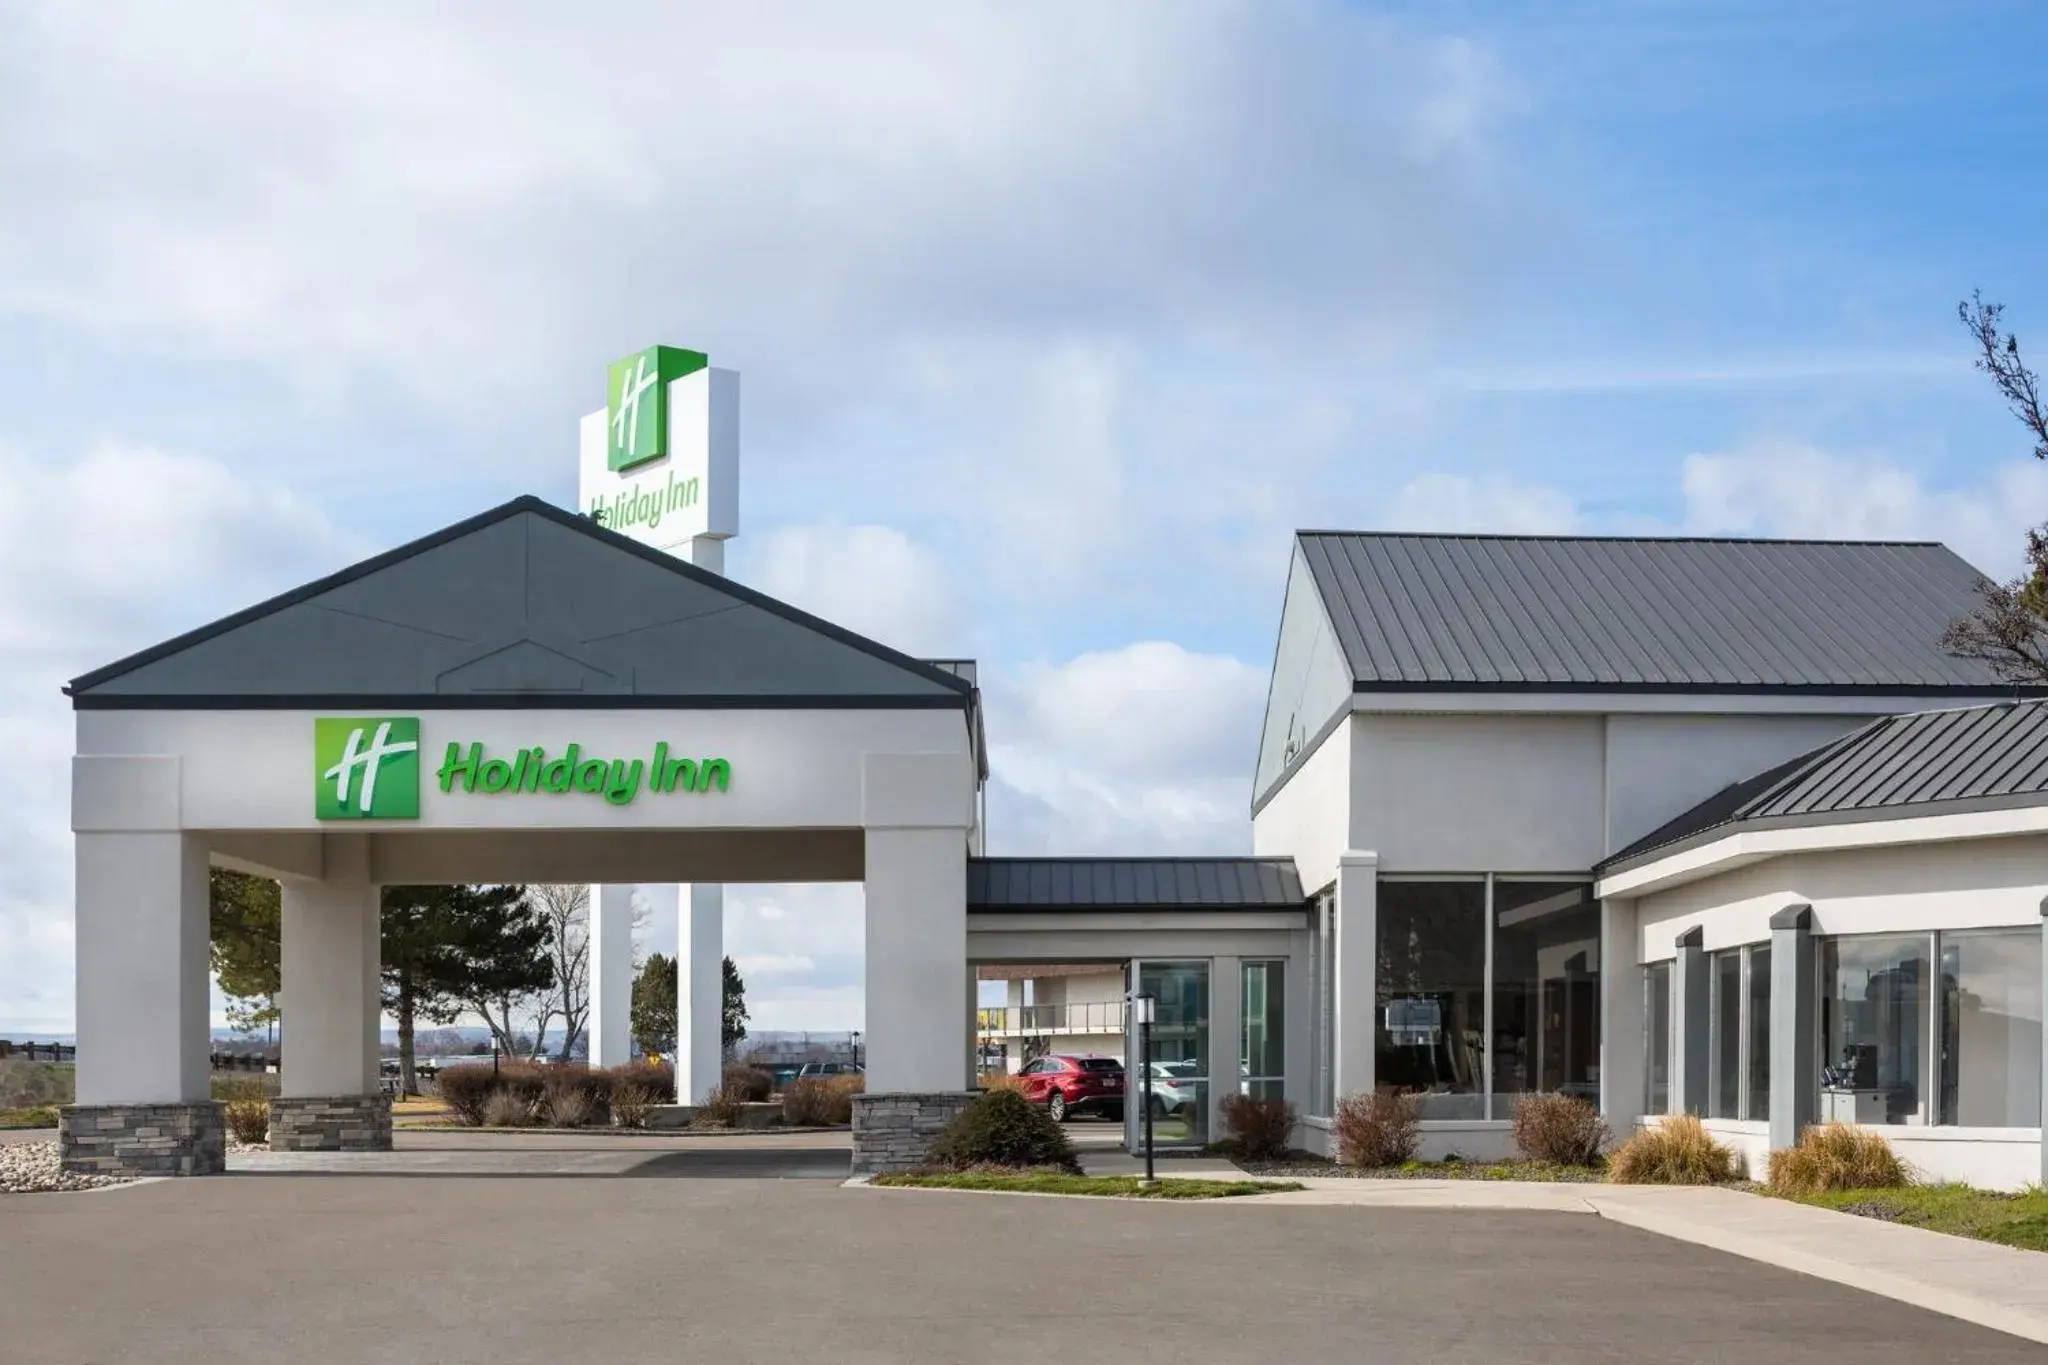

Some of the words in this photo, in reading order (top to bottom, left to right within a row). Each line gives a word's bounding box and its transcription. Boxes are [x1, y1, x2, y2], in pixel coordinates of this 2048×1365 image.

[666, 470, 699, 514] Inn
[438, 742, 643, 805] Holiday
[649, 741, 731, 793] Inn
